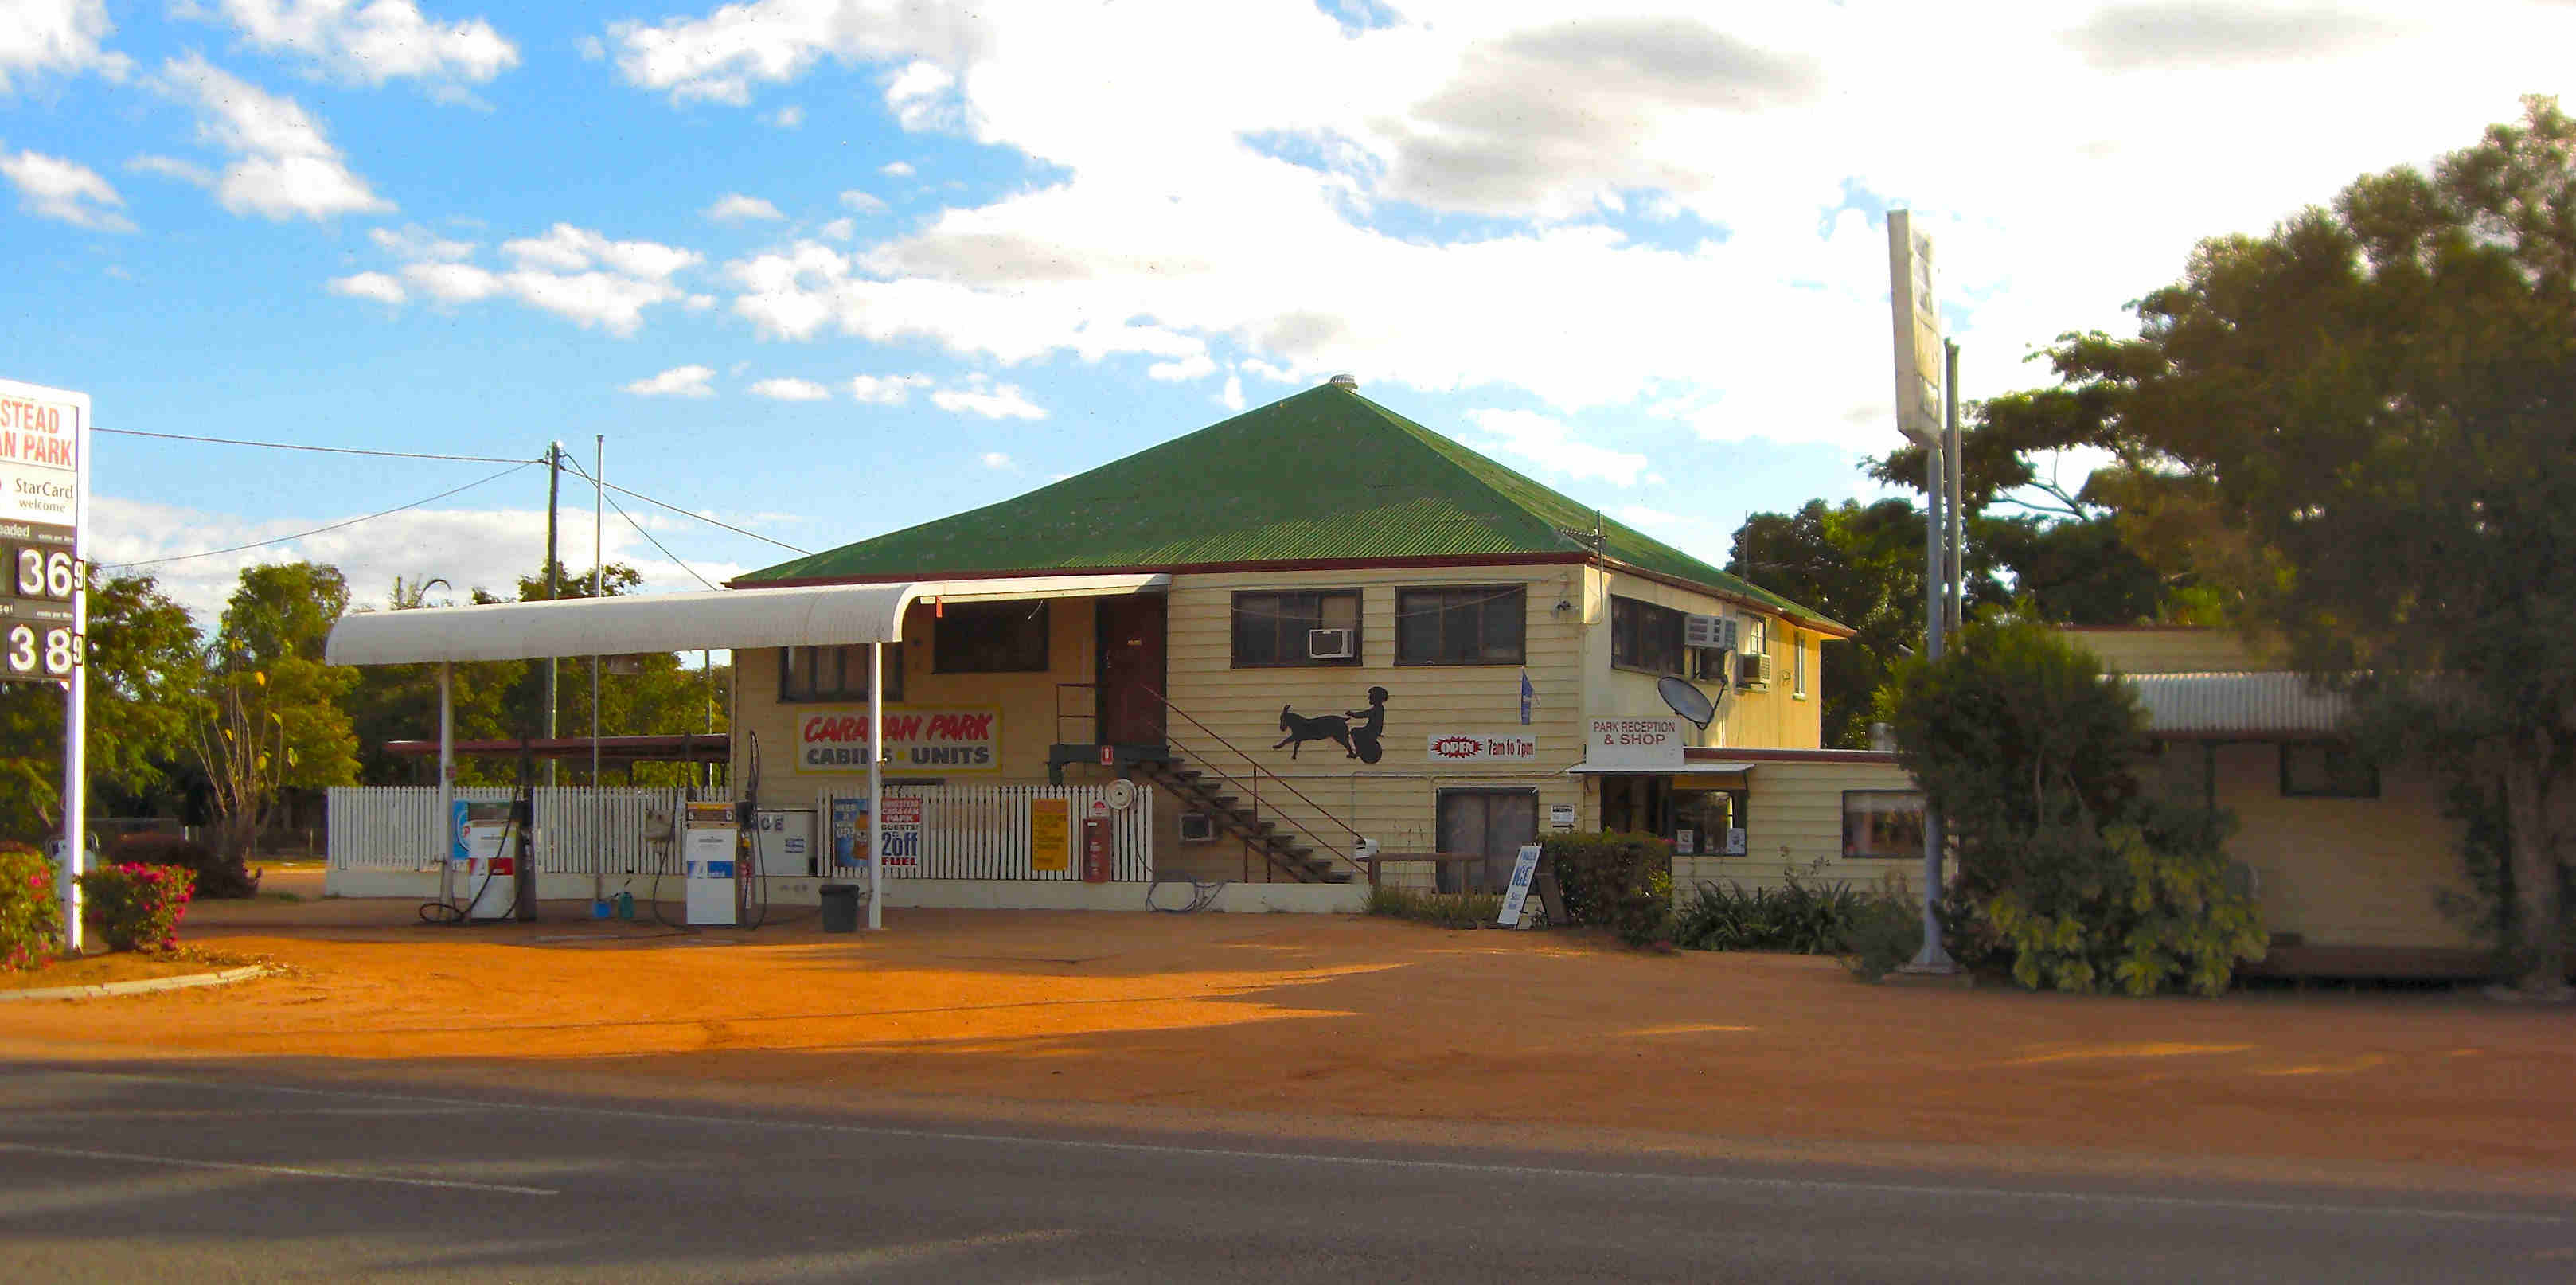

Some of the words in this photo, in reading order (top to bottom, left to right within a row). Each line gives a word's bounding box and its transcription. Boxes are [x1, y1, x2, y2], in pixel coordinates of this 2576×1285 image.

[0, 399, 60, 434] STEAD
[0, 431, 16, 458] N
[24, 434, 72, 466] PARK
[15, 478, 74, 499] StarCard
[19, 498, 66, 513] welcome
[74, 560, 84, 590] 9
[73, 635, 83, 664] 9
[804, 717, 922, 743] CARAAN
[927, 714, 993, 741] PARK
[1593, 721, 1618, 732] PARK
[1621, 721, 1675, 732] RECEPTION
[1440, 740, 1474, 754] OPEN
[1487, 738, 1505, 756] 7am
[1506, 738, 1514, 756] to
[1516, 739, 1533, 757] 7pm
[1604, 734, 1614, 745] &
[1620, 734, 1665, 745] SHOP
[911, 746, 989, 765] UNITS
[881, 857, 917, 866] FUEL
